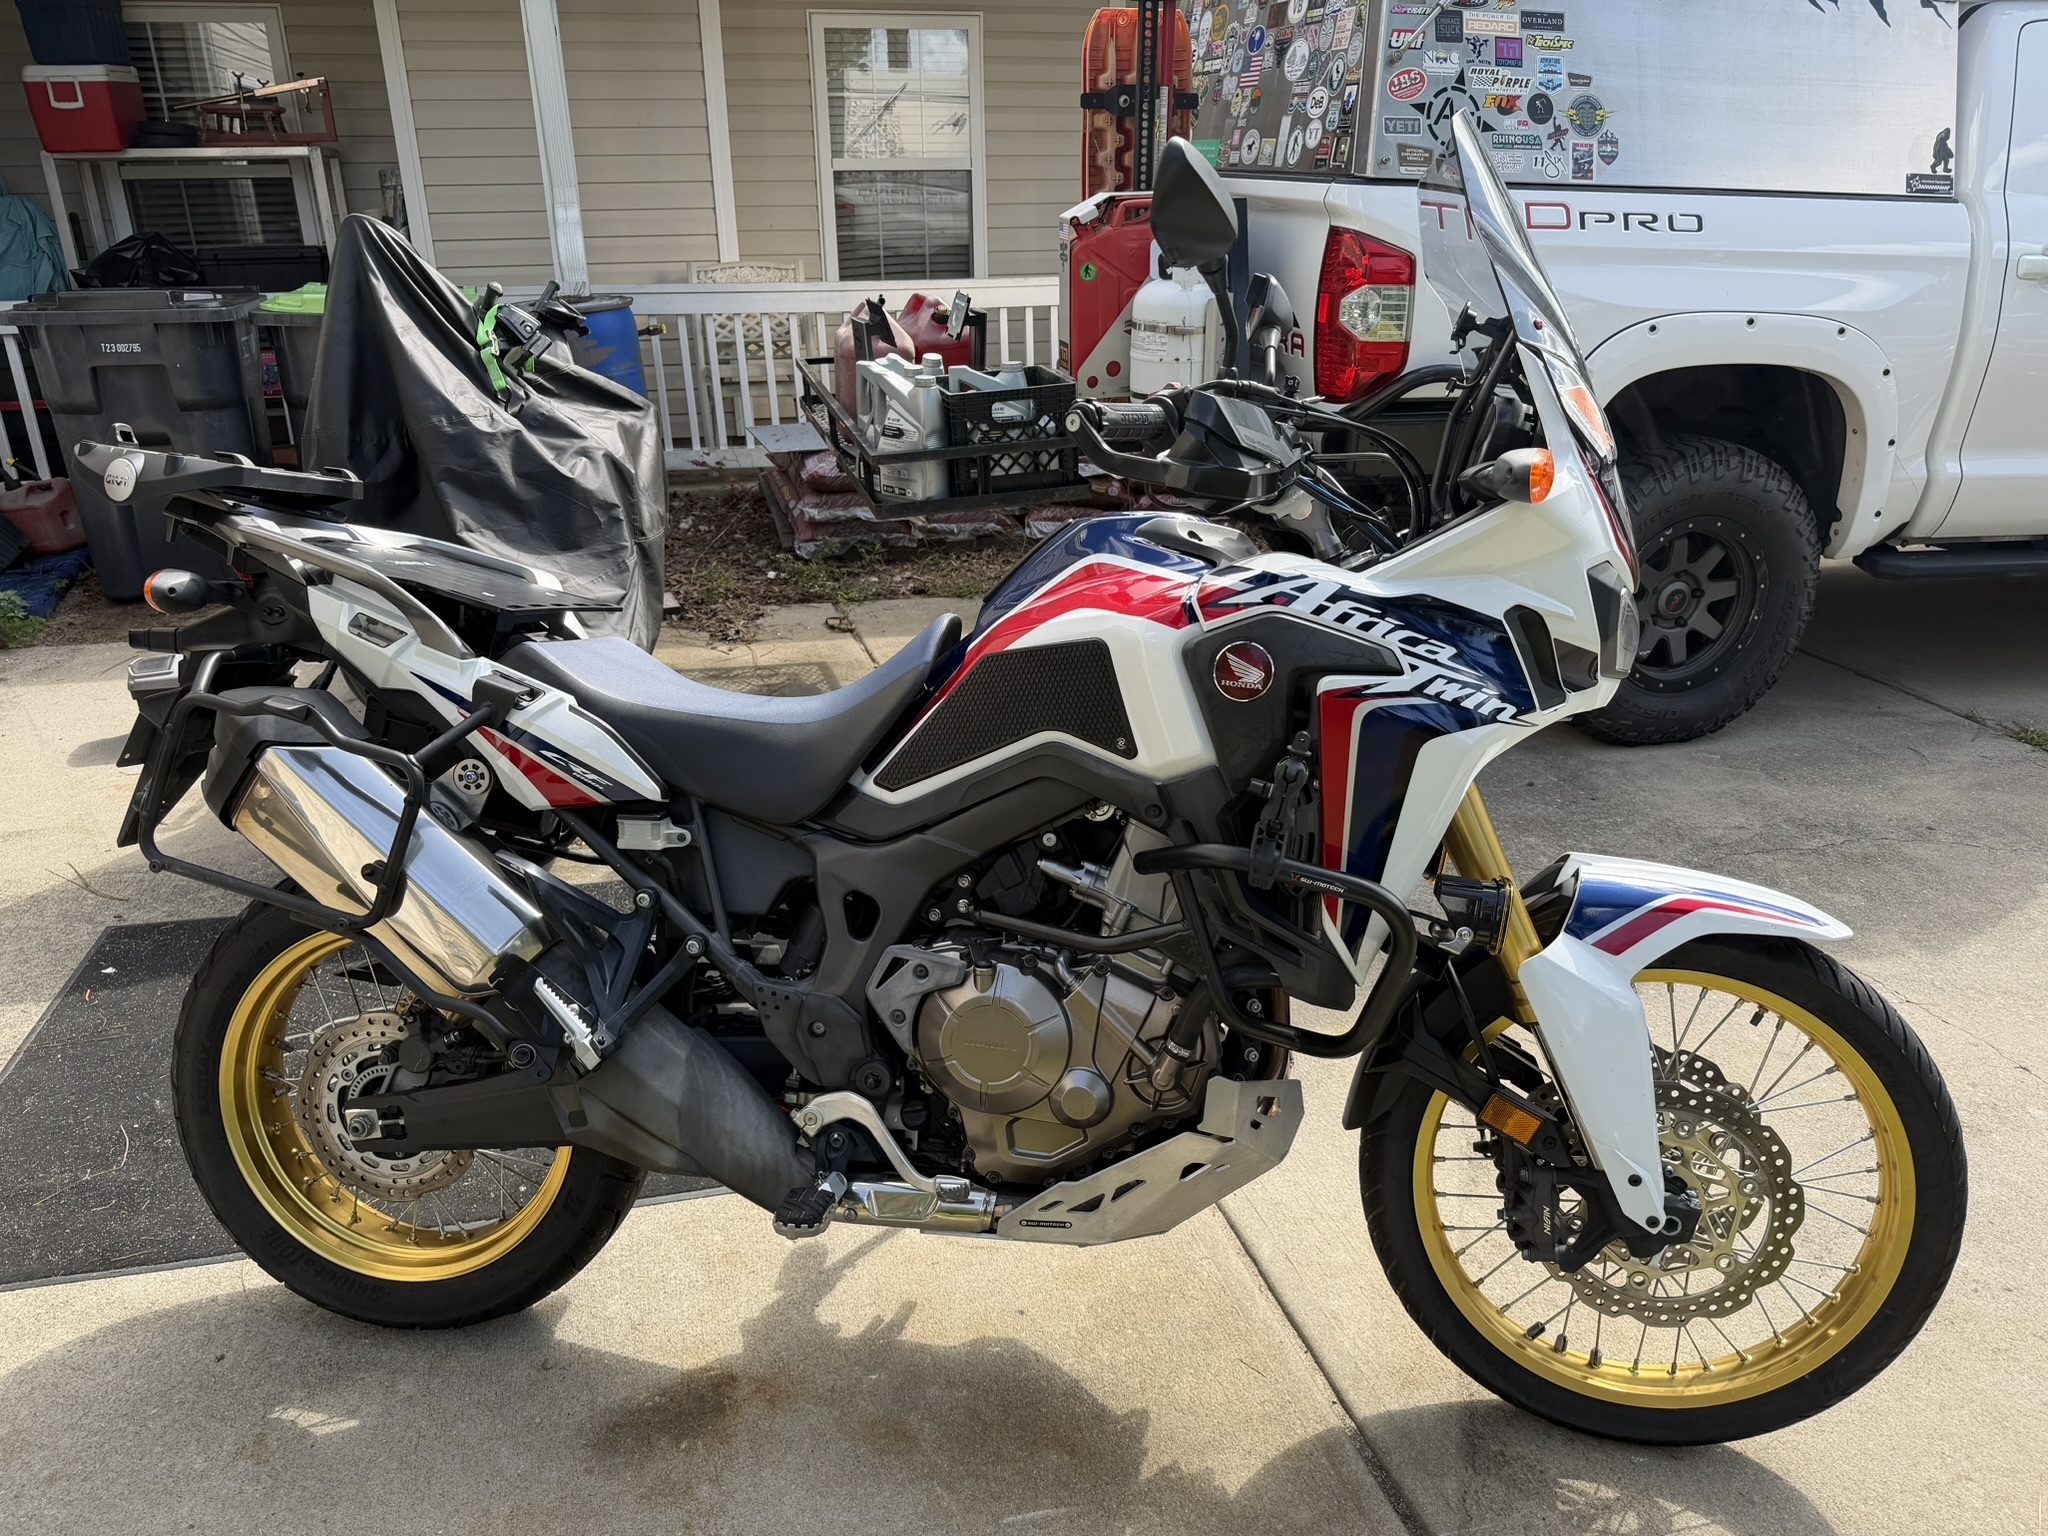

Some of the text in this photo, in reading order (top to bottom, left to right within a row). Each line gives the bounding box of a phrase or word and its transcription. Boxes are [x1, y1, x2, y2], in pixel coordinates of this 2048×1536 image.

[1436, 17, 1461, 25] EMBRACE
[1467, 20, 1515, 32] REDARC
[1521, 16, 1563, 26] OVERLAND
[1440, 24, 1461, 35] SUCK
[1470, 67, 1501, 76] ROYAL
[1309, 95, 1325, 110] DeB
[1482, 94, 1523, 109] FOX
[1308, 127, 1320, 140] YT
[1384, 119, 1420, 134] YETI
[1579, 211, 1704, 233] PRO
[105, 473, 129, 488] GIVI
[1218, 573, 1482, 678] Africa
[1220, 679, 1264, 692] HONDA
[1361, 655, 1538, 728] Twin
[539, 749, 615, 787] CRF
[1299, 876, 1346, 894] SW-MOTECH
[1542, 1204, 1552, 1236] NISSIN
